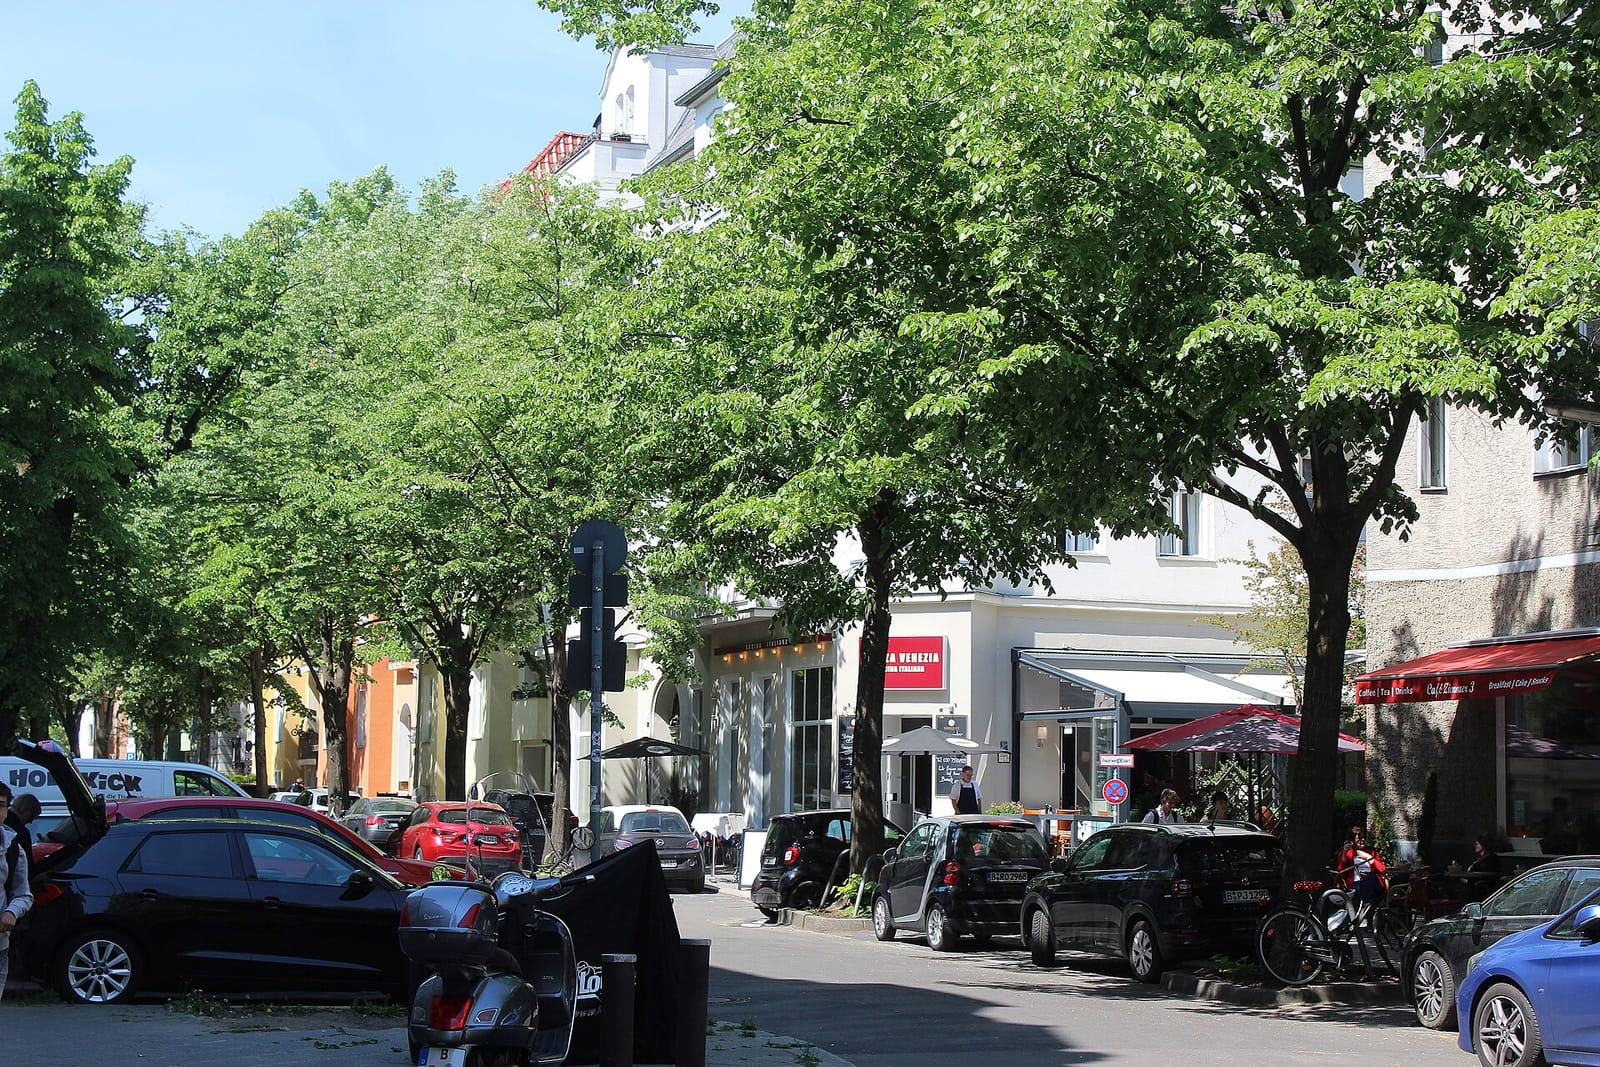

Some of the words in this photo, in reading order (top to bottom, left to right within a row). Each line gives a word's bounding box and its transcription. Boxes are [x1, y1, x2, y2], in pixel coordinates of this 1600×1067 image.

[899, 653, 940, 663] VENEZIA
[1488, 680, 1511, 690] Breakfast
[1515, 679, 1528, 687] Cake
[1531, 676, 1549, 685] Snacks
[1359, 688, 1376, 697] Coffee
[1381, 688, 1390, 696] Tea
[1395, 686, 1413, 695] Drinks
[1426, 682, 1443, 698] Café
[1443, 682, 1468, 695] Zimmer
[1469, 680, 1475, 693] 3
[440, 1049, 449, 1060] B
